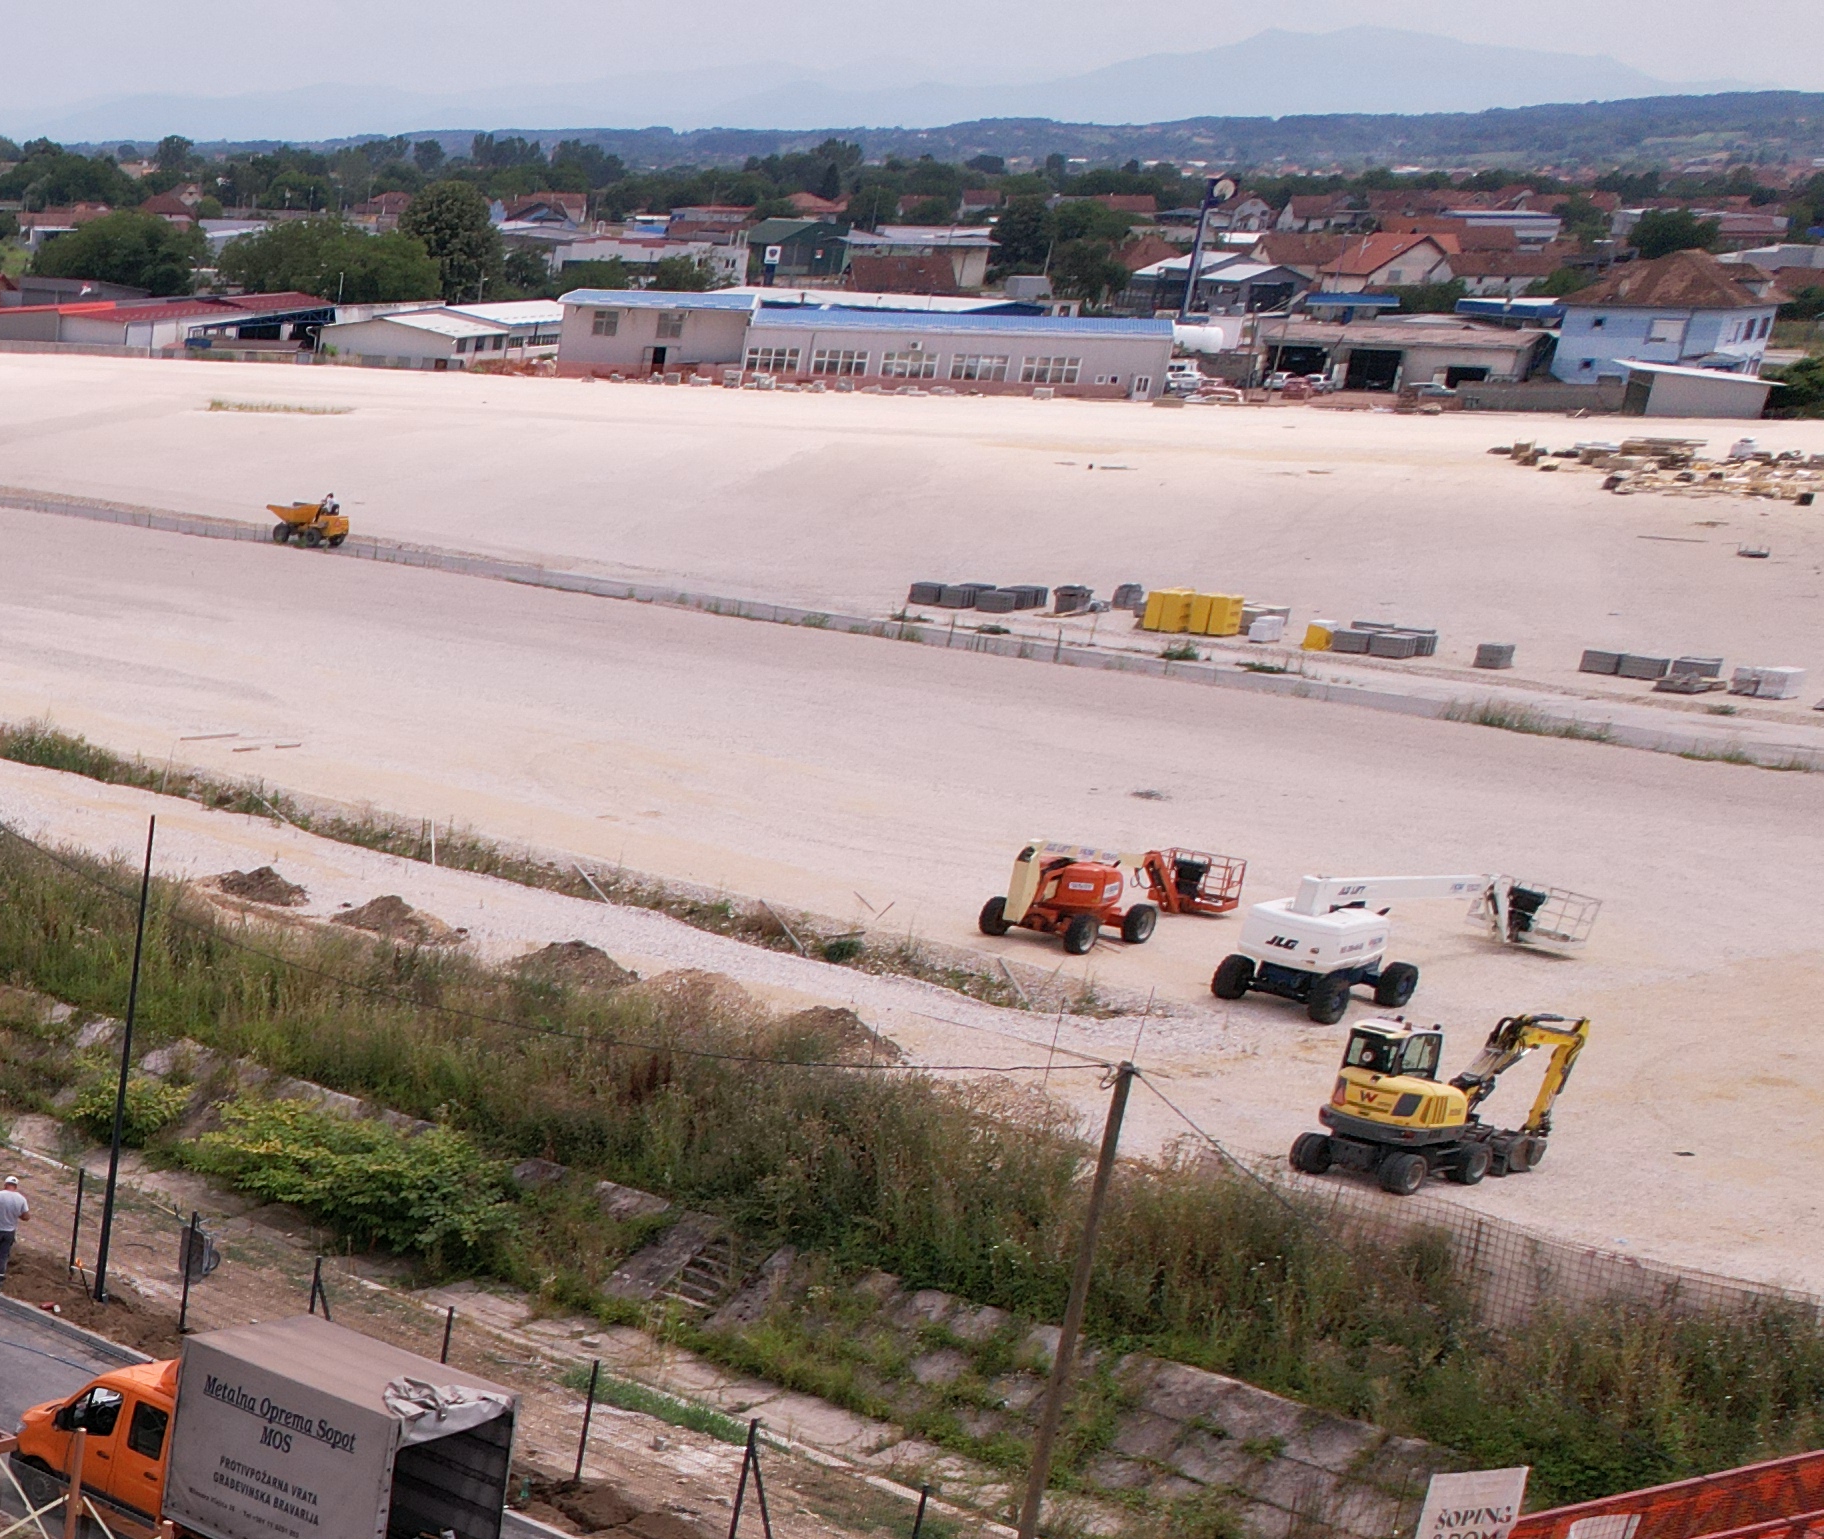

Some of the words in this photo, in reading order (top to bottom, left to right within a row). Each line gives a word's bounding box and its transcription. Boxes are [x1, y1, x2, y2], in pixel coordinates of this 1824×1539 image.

[1265, 935, 1299, 950] JLG
[204, 1374, 255, 1411] Metalna
[260, 1397, 313, 1434] Oprema
[316, 1418, 356, 1450] Sopot
[260, 1426, 292, 1453] MOS
[219, 1455, 289, 1493] PROTIVPOŽARNA
[291, 1484, 318, 1506] VRATA
[272, 1497, 319, 1526] BRAVARIJA
[1434, 1506, 1512, 1530] ŠOPING
